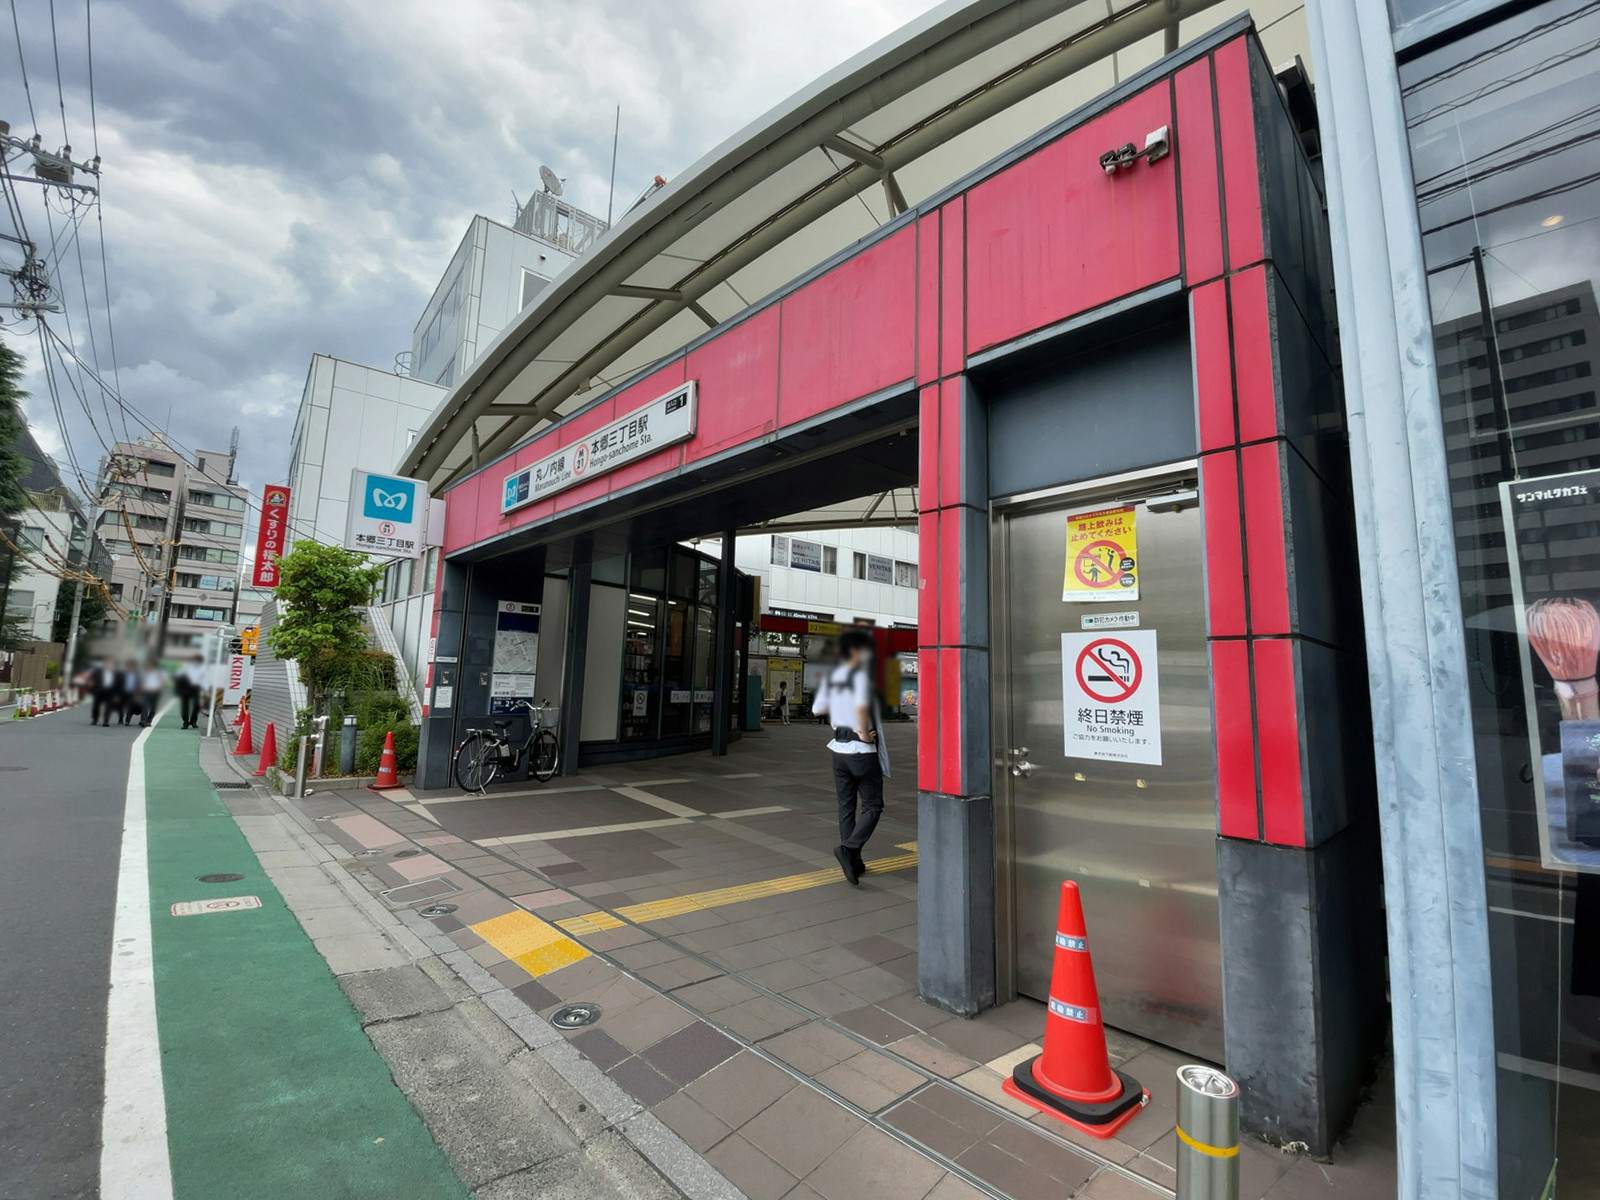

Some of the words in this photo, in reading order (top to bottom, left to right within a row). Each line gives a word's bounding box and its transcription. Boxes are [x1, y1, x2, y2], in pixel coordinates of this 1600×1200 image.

[679, 395, 684, 407] 1
[591, 414, 649, 455] 本郷三丁目駅
[578, 449, 585, 458] M
[589, 440, 639, 469] Hongo-sanchome
[640, 434, 653, 446] Sta.
[535, 456, 566, 482] 丸ノ内線
[576, 458, 585, 470] 21
[1516, 485, 1588, 502] サンマルクカフェ
[356, 533, 415, 549] 本郷三丁目駅
[1071, 526, 1132, 542] 止めてください
[260, 508, 280, 583] くすりの福太郎
[792, 556, 820, 566] VERITAS
[229, 657, 244, 690] KIRIN
[1077, 707, 1144, 727] 終日禁煙
[1086, 724, 1098, 733] No
[1100, 726, 1135, 737] Smoking
[1072, 733, 1151, 746] ご協力をお願いいたします。
